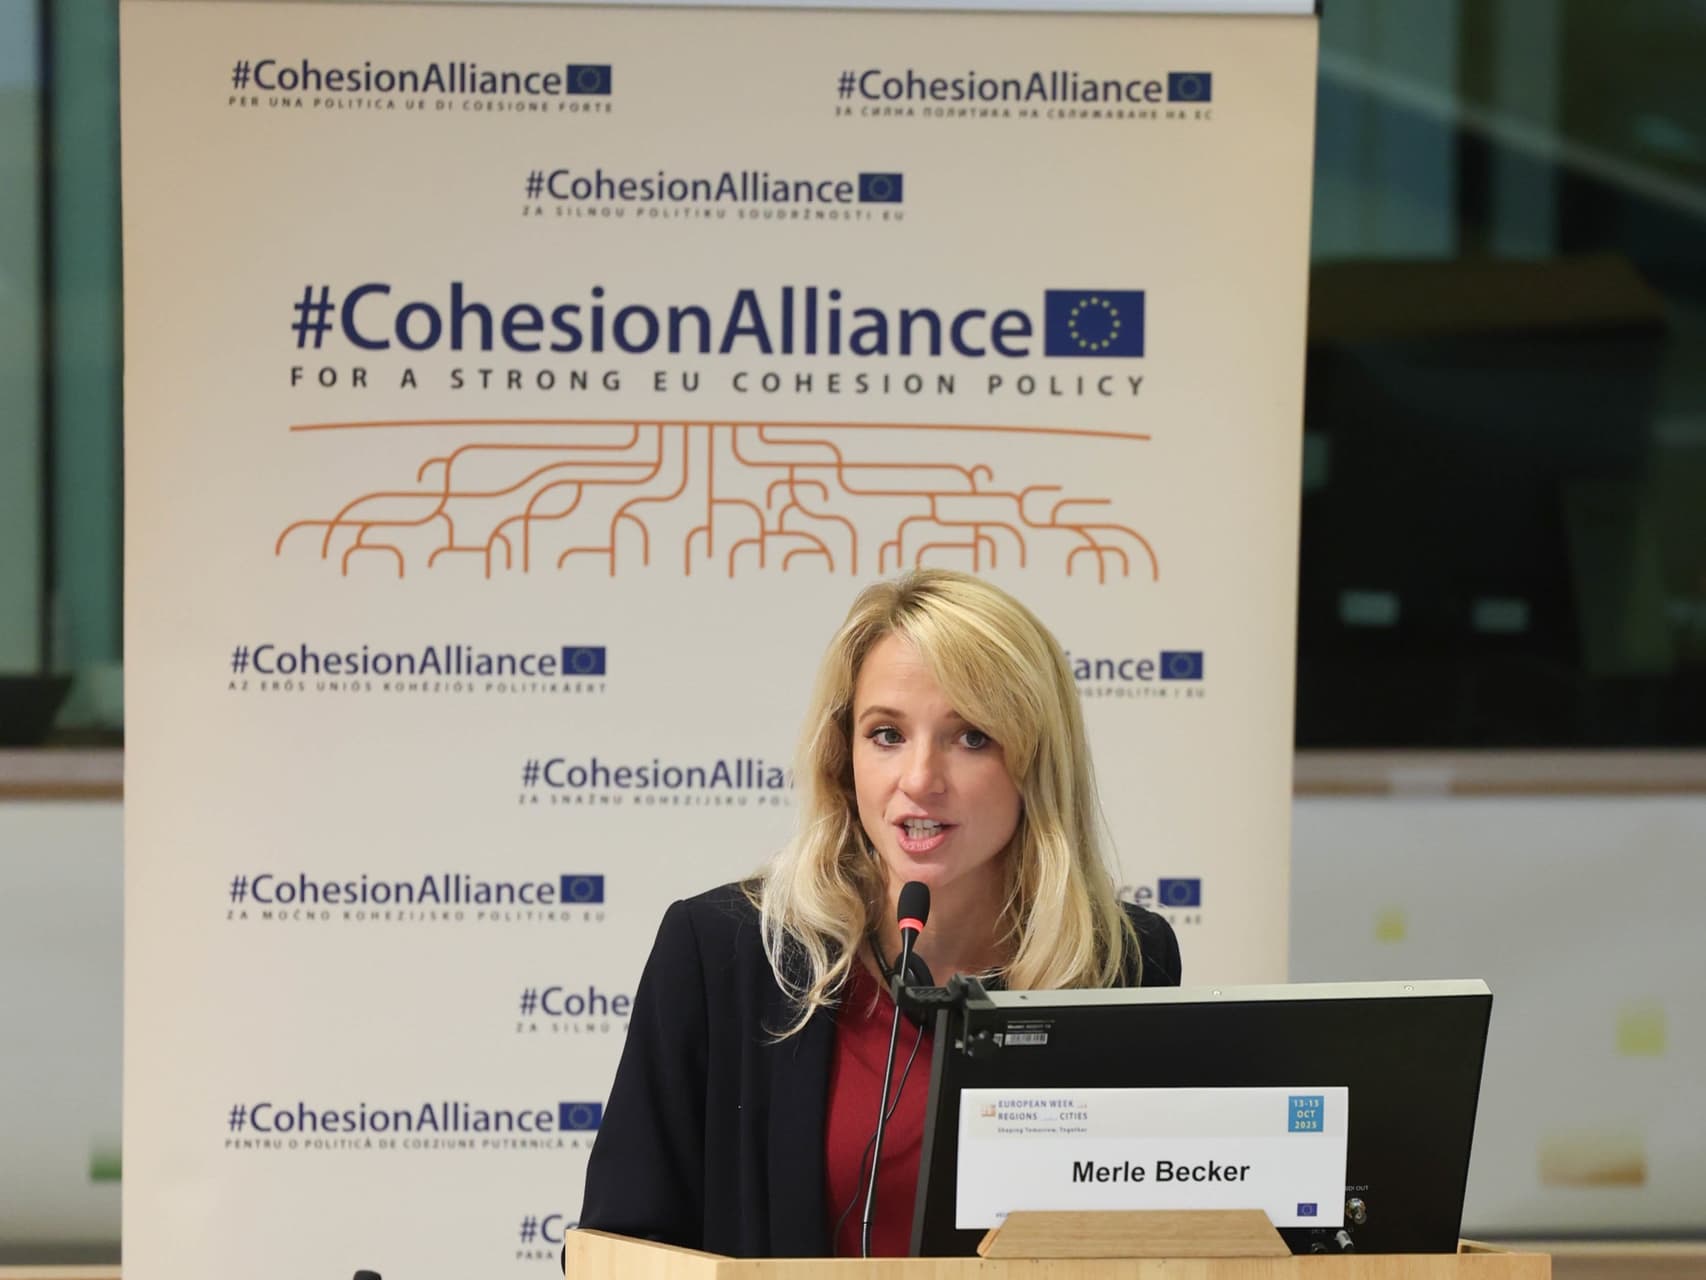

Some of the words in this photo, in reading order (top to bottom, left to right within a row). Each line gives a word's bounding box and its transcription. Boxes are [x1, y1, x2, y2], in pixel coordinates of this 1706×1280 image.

[231, 60, 562, 94] #CohesionAlliance
[837, 69, 1163, 103] #CohesionAlliance
[228, 95, 259, 107] PER
[269, 97, 303, 108] UNA
[313, 97, 395, 110] POLITICA
[405, 99, 425, 110] UE
[435, 99, 453, 111] DI
[462, 100, 548, 113] COESIONE
[558, 101, 612, 113] FORTE
[526, 168, 854, 204] #CohesionAlliance
[522, 205, 543, 217] ZA
[555, 205, 625, 218] SILNOU
[636, 206, 726, 219] POLITIKU
[291, 283, 1033, 359] #CohesionAlliance
[290, 366, 367, 388] FOR
[400, 368, 417, 389] A
[450, 368, 620, 391] STRONG
[653, 371, 700, 392] EU
[732, 371, 955, 395] COHESION
[987, 374, 1143, 397] POLICY
[232, 644, 557, 677] #CohesionAlliance
[230, 873, 555, 905] #CohesionAlliance
[476, 910, 571, 923] POLITIKO
[229, 1101, 554, 1133] #CohesionAlliance
[997, 1110, 1038, 1119] REGIONS
[1058, 1109, 1088, 1119] CITIES
[998, 1099, 1047, 1109] EUROPEAN
[1049, 1099, 1074, 1109] WEEK
[1297, 1110, 1315, 1118] OCT
[224, 1138, 282, 1149] PENTRU
[378, 1138, 396, 1150] DE
[1072, 1160, 1146, 1183] Merle
[1155, 1159, 1251, 1182] Becker
